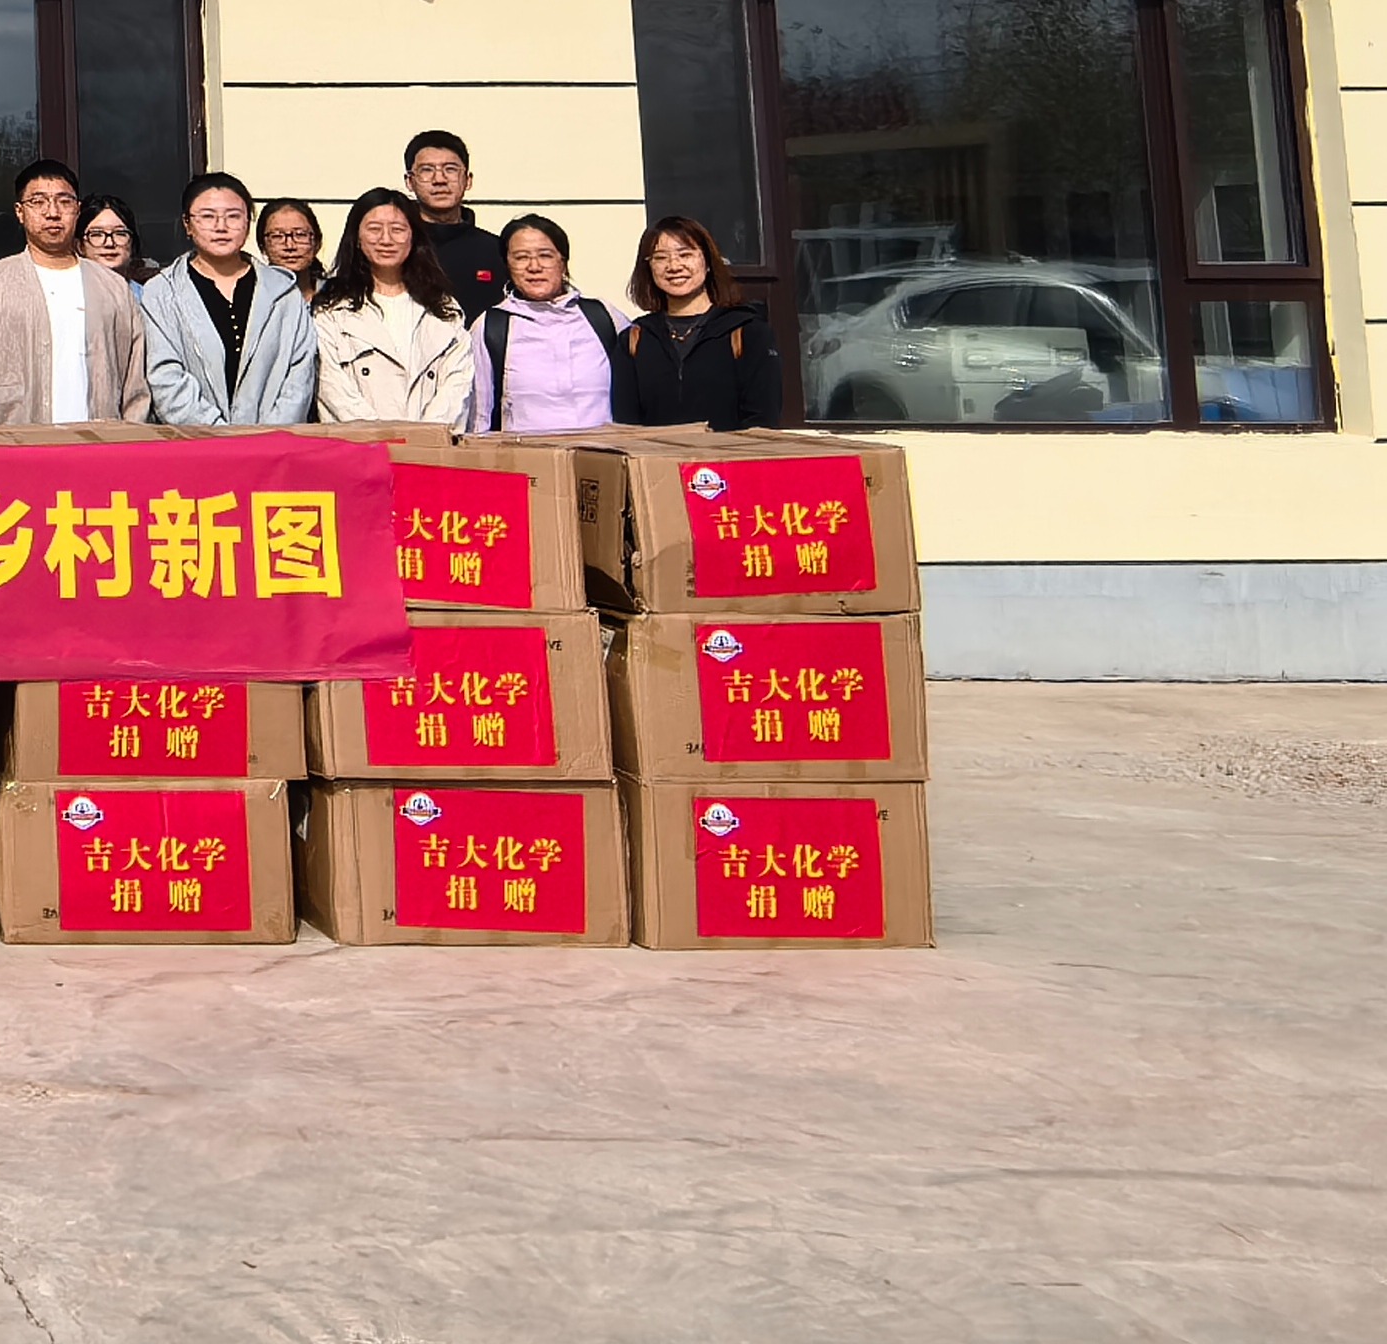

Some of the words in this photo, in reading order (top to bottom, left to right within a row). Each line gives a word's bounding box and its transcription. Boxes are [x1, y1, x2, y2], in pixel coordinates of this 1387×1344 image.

[391, 508, 508, 547] 大化学
[713, 502, 849, 538] 吉大化学
[395, 545, 482, 587] 捐赠
[743, 542, 829, 577] 捐赠
[82, 684, 225, 719] 吉大化学
[388, 672, 528, 706] 吉大化学
[723, 669, 863, 702] 吉大化学
[108, 727, 200, 758] 捐赠
[415, 713, 506, 747] 捐赠
[751, 709, 841, 742] 捐赠
[81, 836, 227, 872] 吉大化学
[419, 834, 563, 872] 吉大化学
[719, 845, 860, 878] 吉大化学
[110, 879, 202, 912] 捐赠
[446, 876, 536, 912] 捐赠
[746, 886, 836, 919] 捐赠
